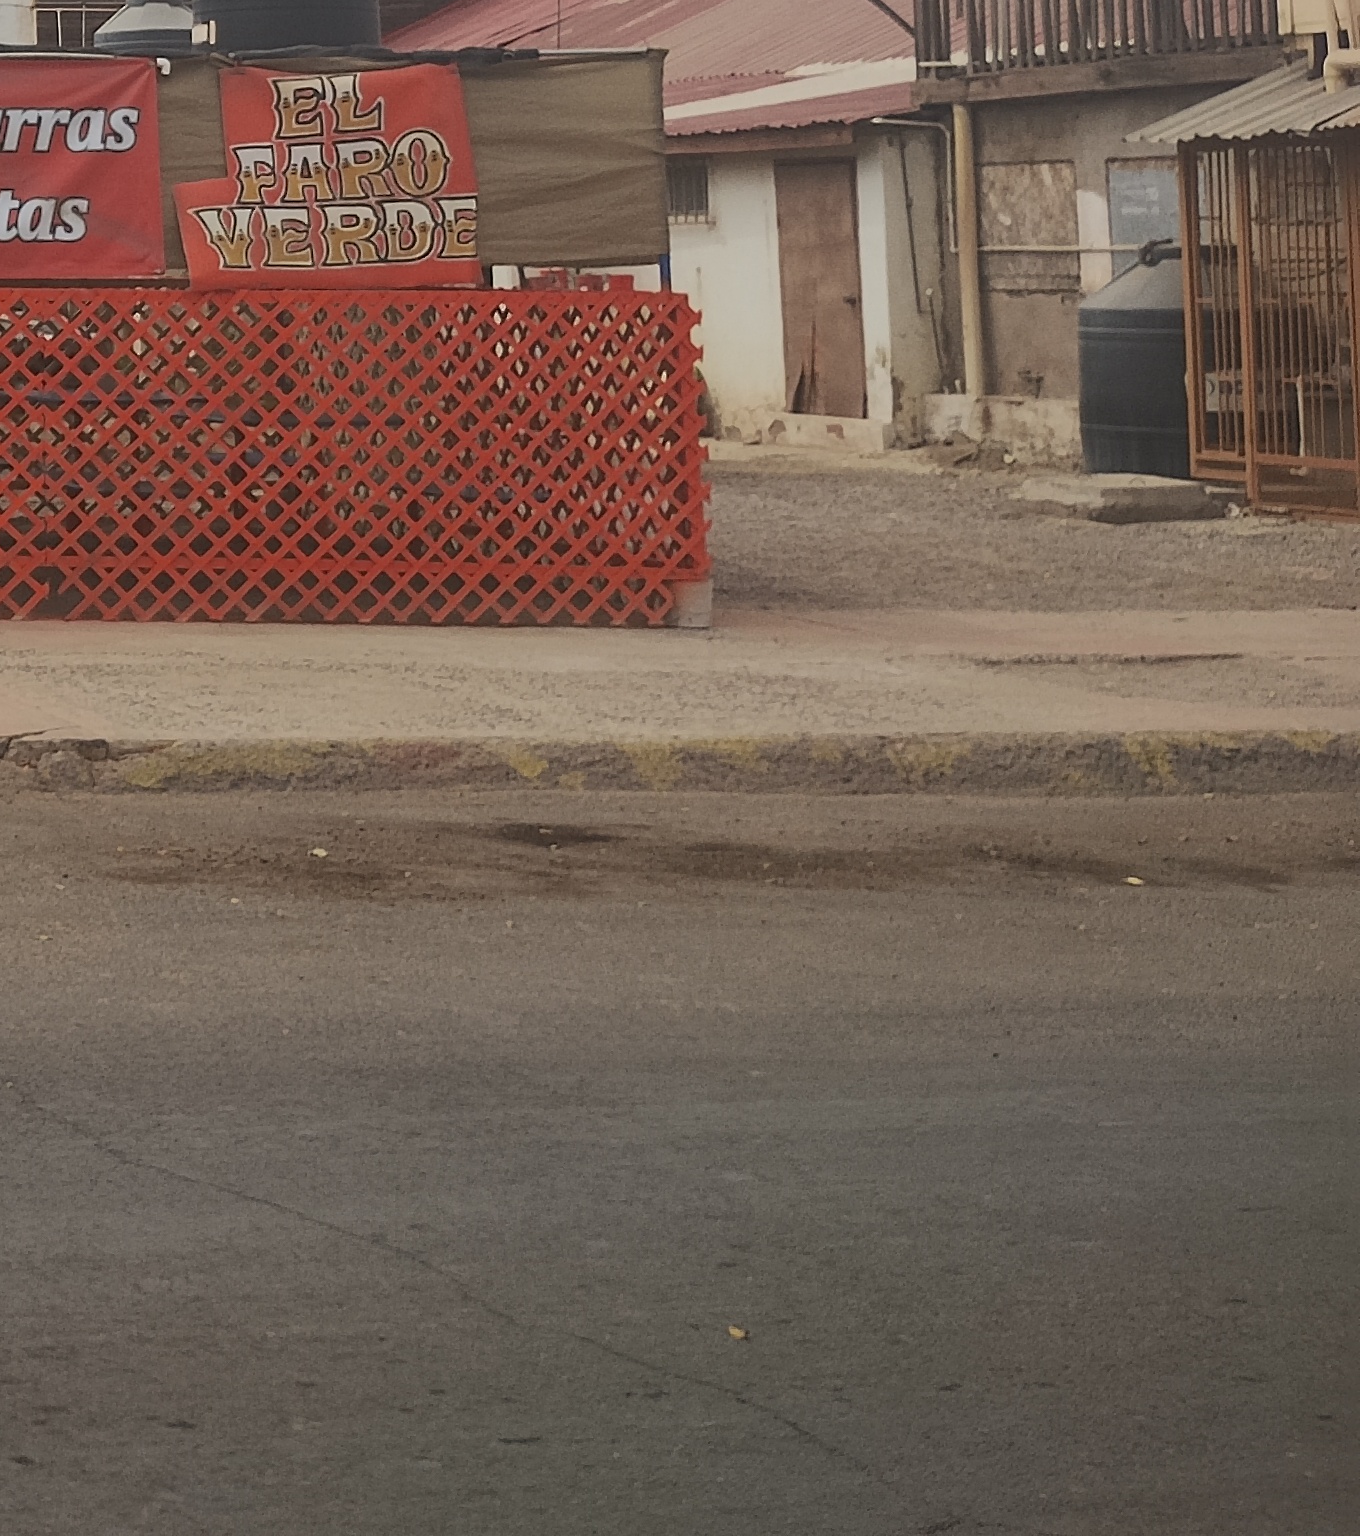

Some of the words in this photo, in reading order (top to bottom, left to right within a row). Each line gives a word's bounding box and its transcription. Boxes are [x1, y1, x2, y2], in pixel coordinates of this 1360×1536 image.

[267, 72, 386, 142] EL
[230, 128, 453, 205] FARO
[187, 192, 478, 271] VERDE
